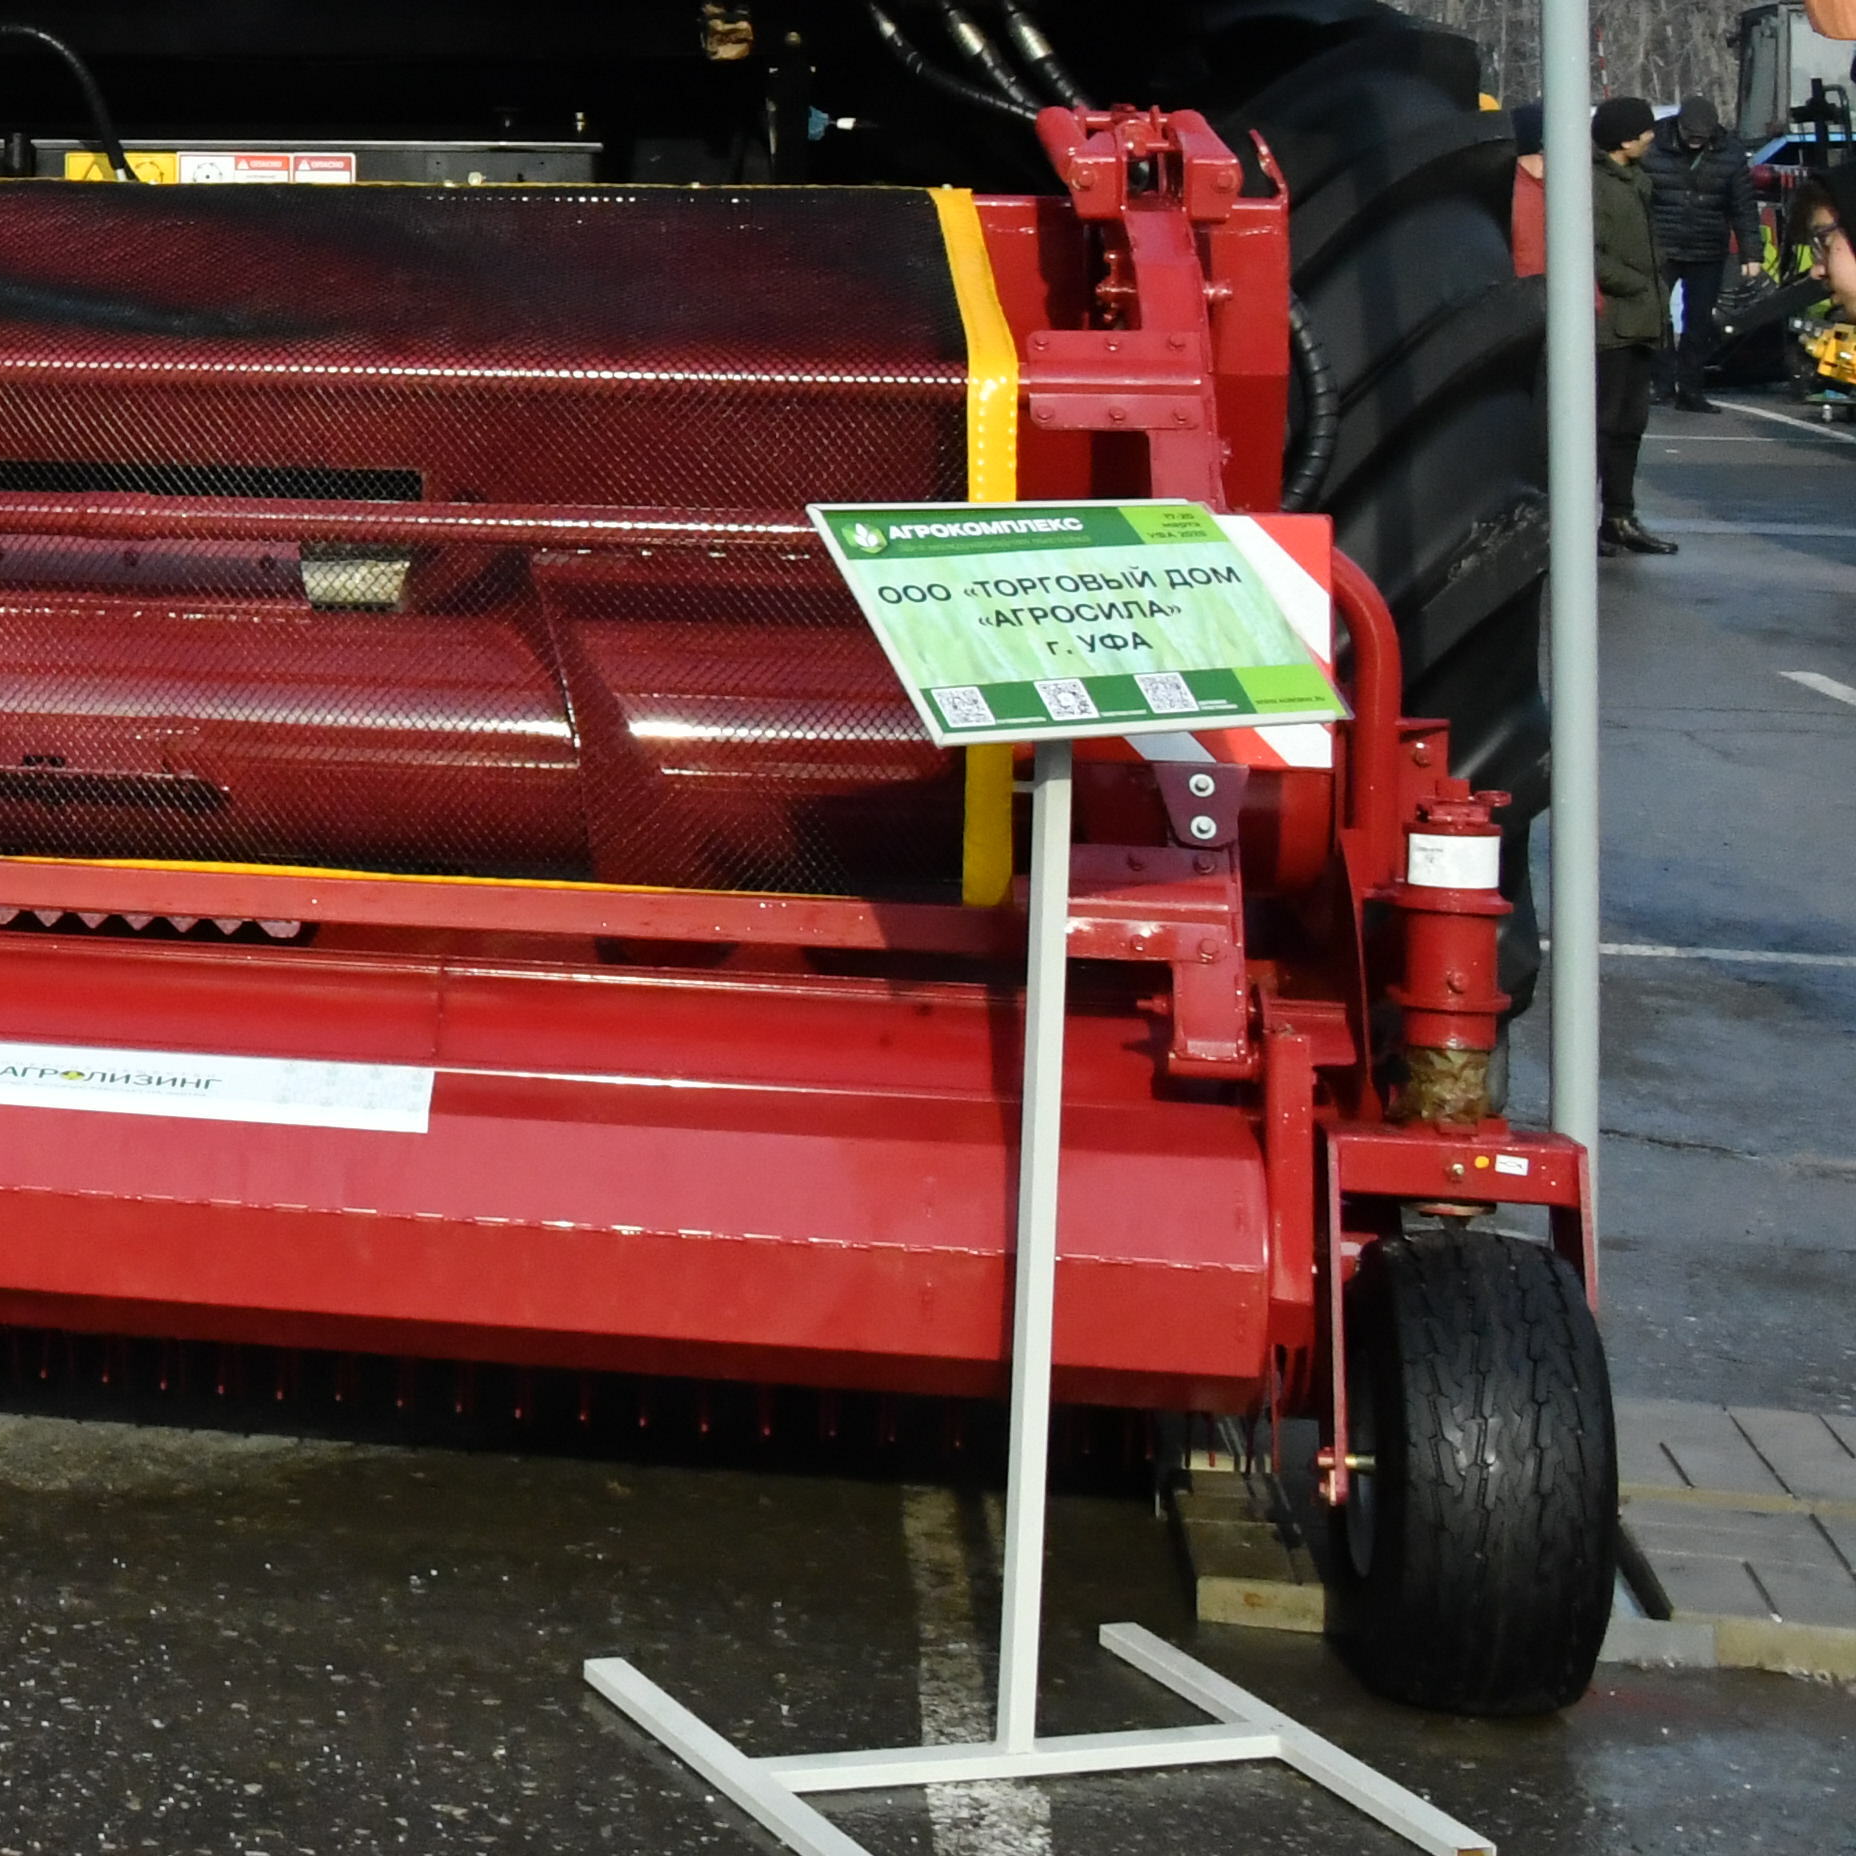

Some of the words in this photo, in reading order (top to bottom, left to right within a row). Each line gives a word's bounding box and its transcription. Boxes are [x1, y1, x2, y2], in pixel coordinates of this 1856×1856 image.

[888, 517, 1084, 540] АГРОКОМПЛЕКС
[877, 581, 953, 606] ООО
[963, 565, 1158, 600] «ТОРГОВЫЙ
[1165, 565, 1243, 589] ДОМ
[978, 599, 1183, 629] «АГРОСИЛА»
[1046, 639, 1073, 656] г.
[1077, 630, 1154, 654] УФА
